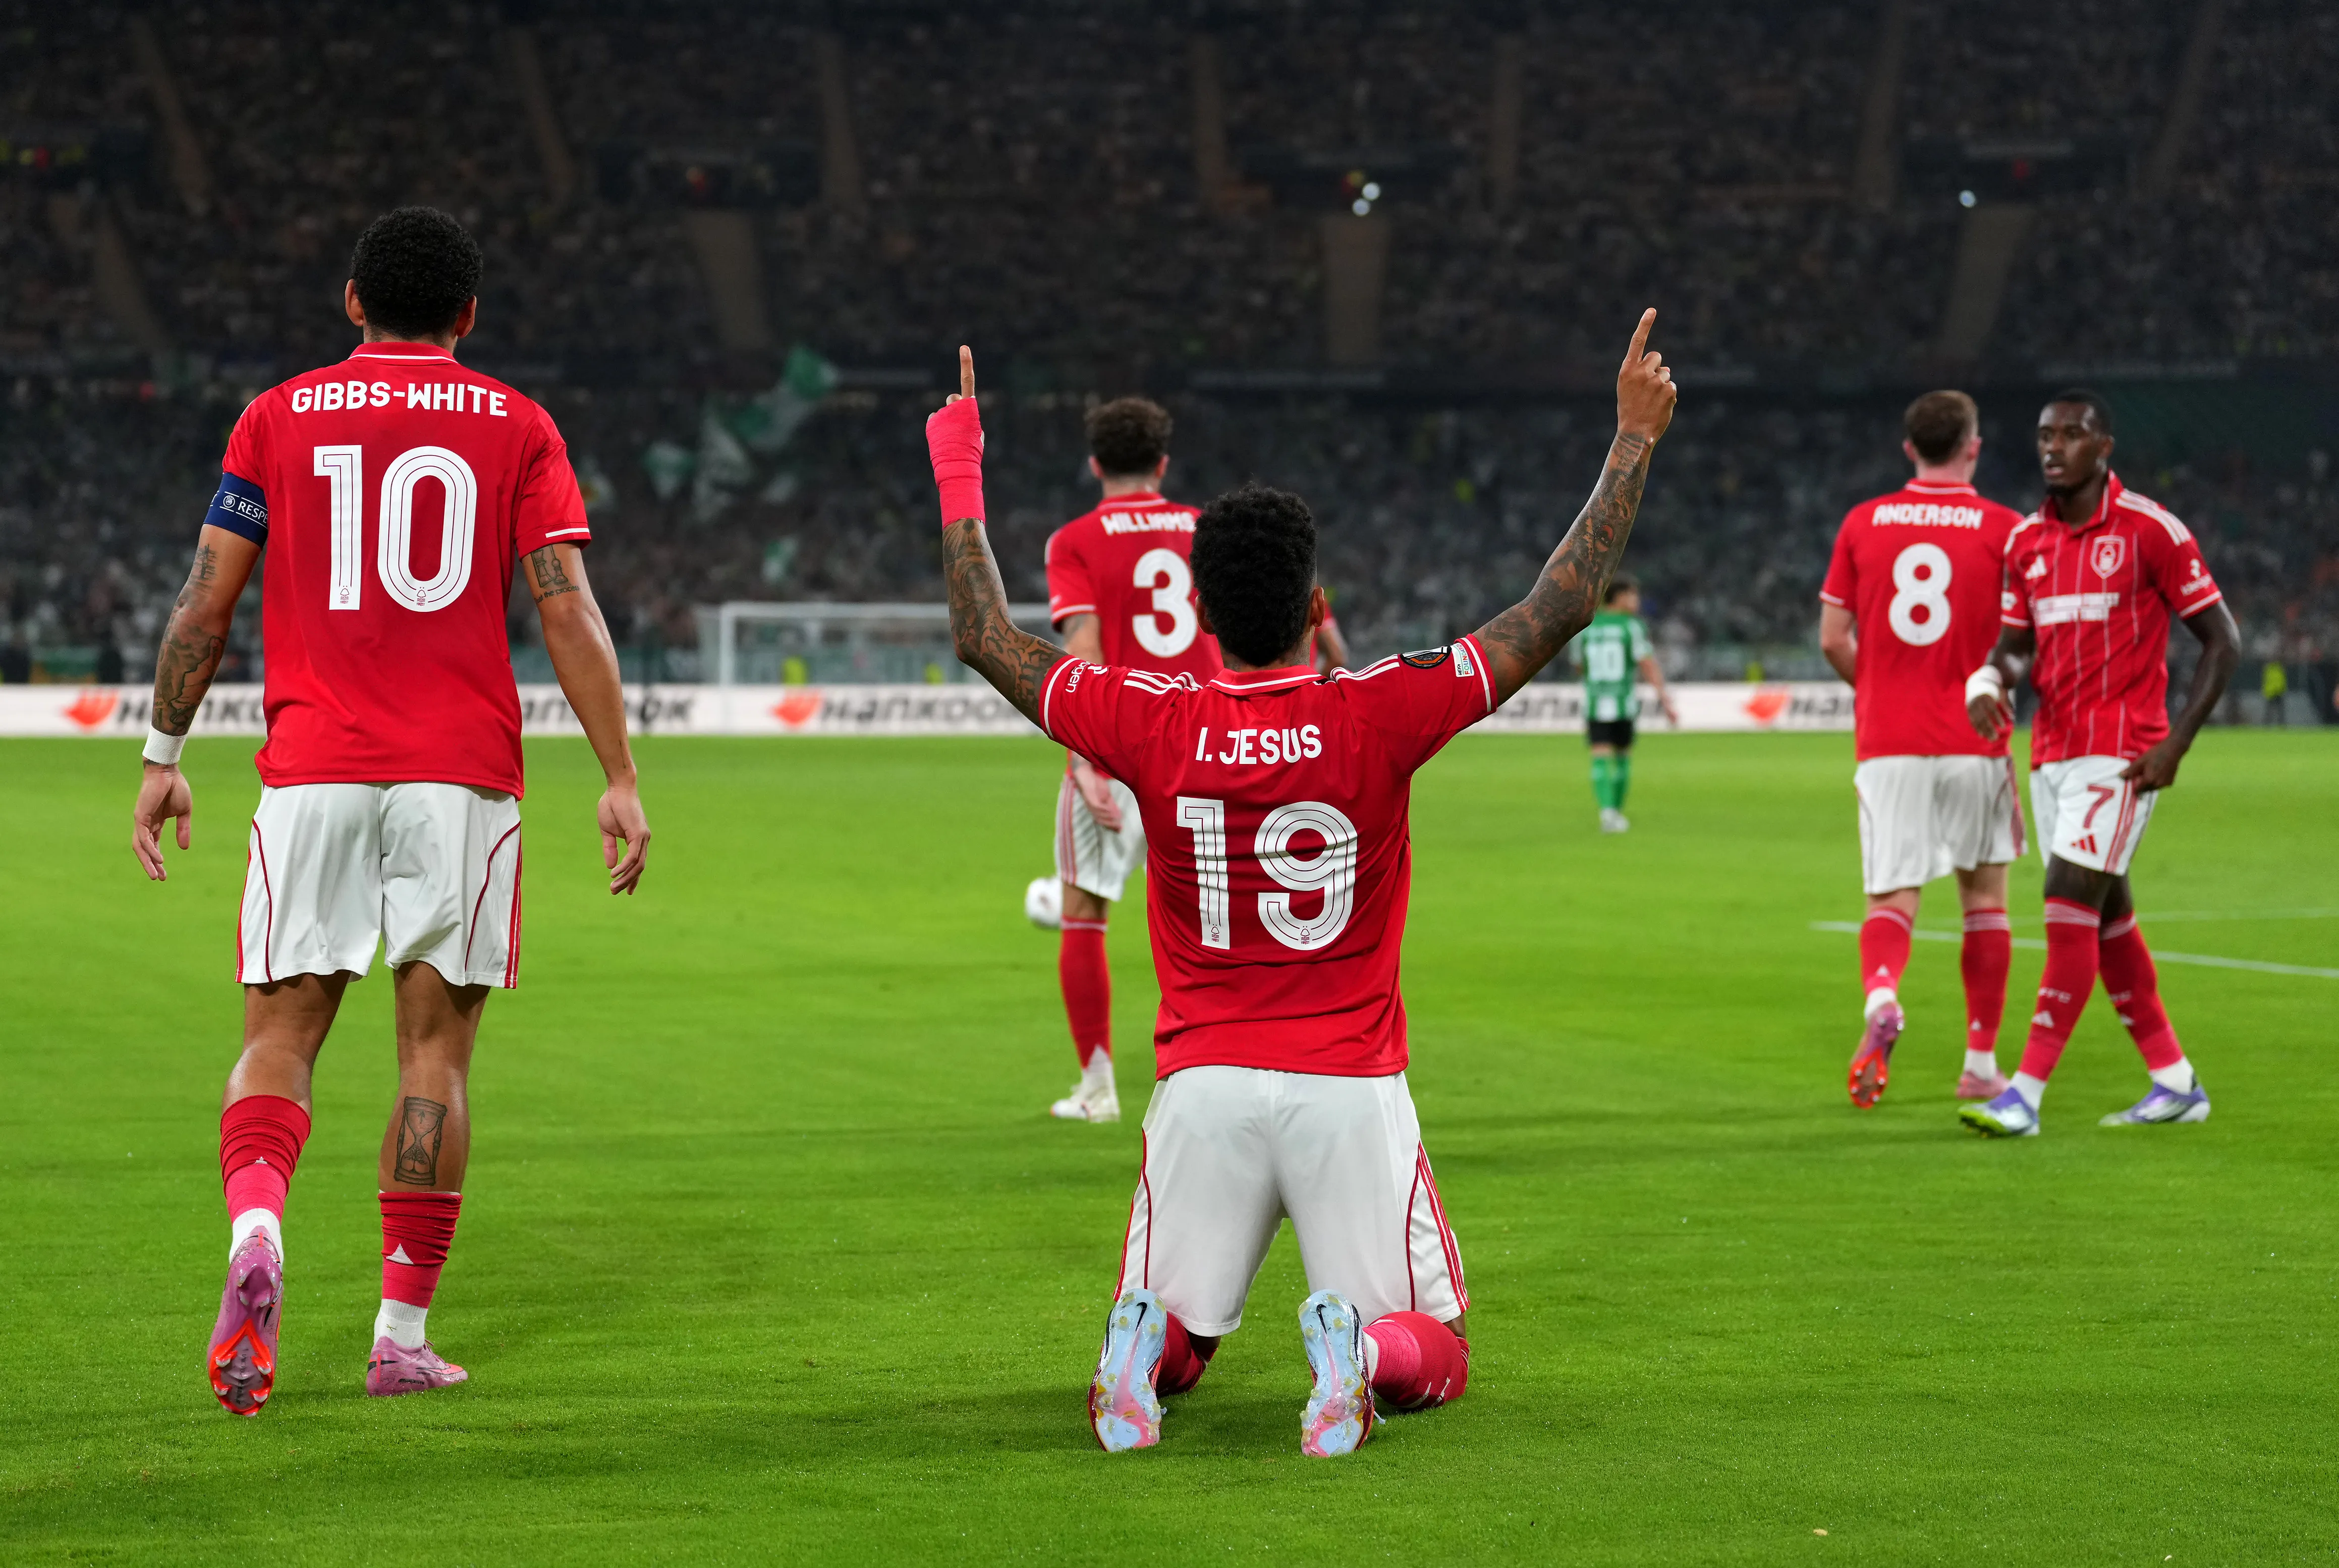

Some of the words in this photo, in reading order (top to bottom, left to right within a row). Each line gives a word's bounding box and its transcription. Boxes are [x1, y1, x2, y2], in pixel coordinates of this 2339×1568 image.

[291, 381, 508, 417] GIBBS-WHITE
[238, 501, 268, 524] RESPE
[314, 445, 477, 612] 10
[1100, 512, 1196, 536] WILLIAMS
[1872, 503, 1983, 530] ANDERSON
[1132, 548, 1197, 658] 3
[1888, 542, 1953, 646] 8
[1195, 727, 1212, 761] I.
[1219, 724, 1322, 764] JESUS
[2086, 784, 2115, 829] 7
[1177, 796, 1358, 950] 19
